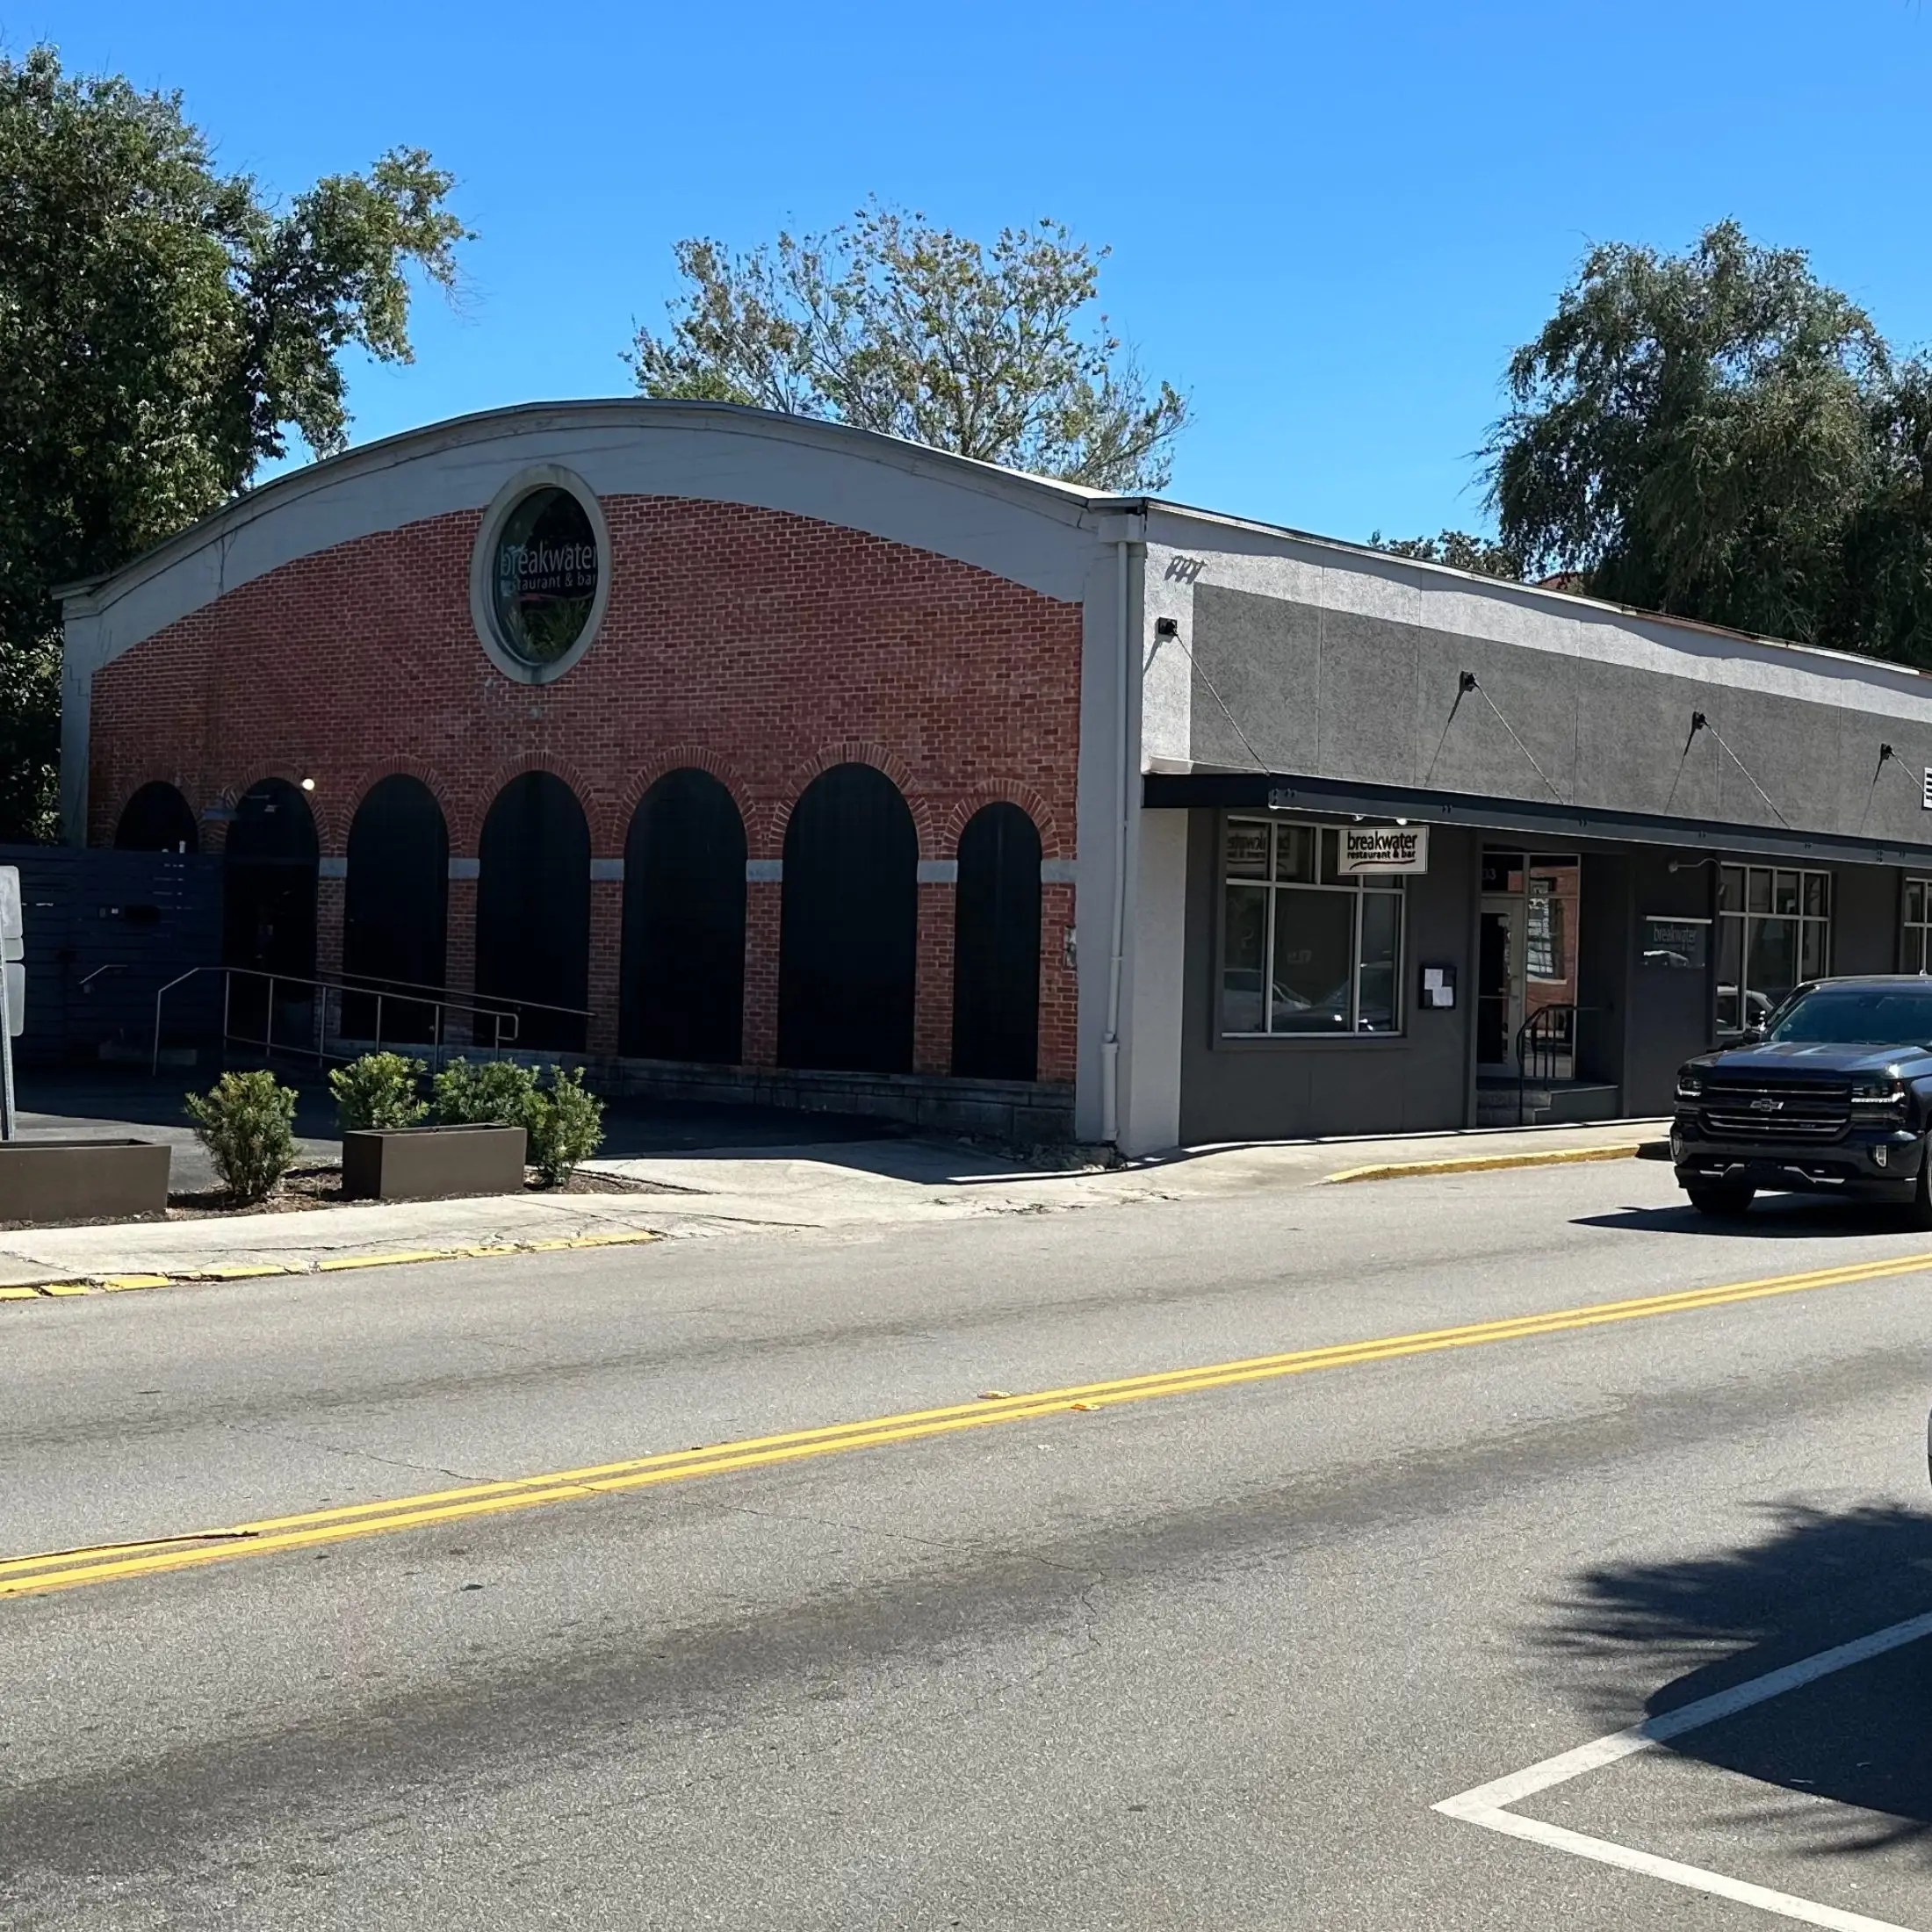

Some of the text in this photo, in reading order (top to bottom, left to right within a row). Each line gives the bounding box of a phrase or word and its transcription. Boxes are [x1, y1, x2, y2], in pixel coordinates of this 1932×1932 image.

[501, 574, 561, 595] staurant
[565, 572, 573, 588] &
[1347, 831, 1418, 850] breakwater
[1347, 850, 1391, 859] restaurant
[1393, 848, 1399, 858] &
